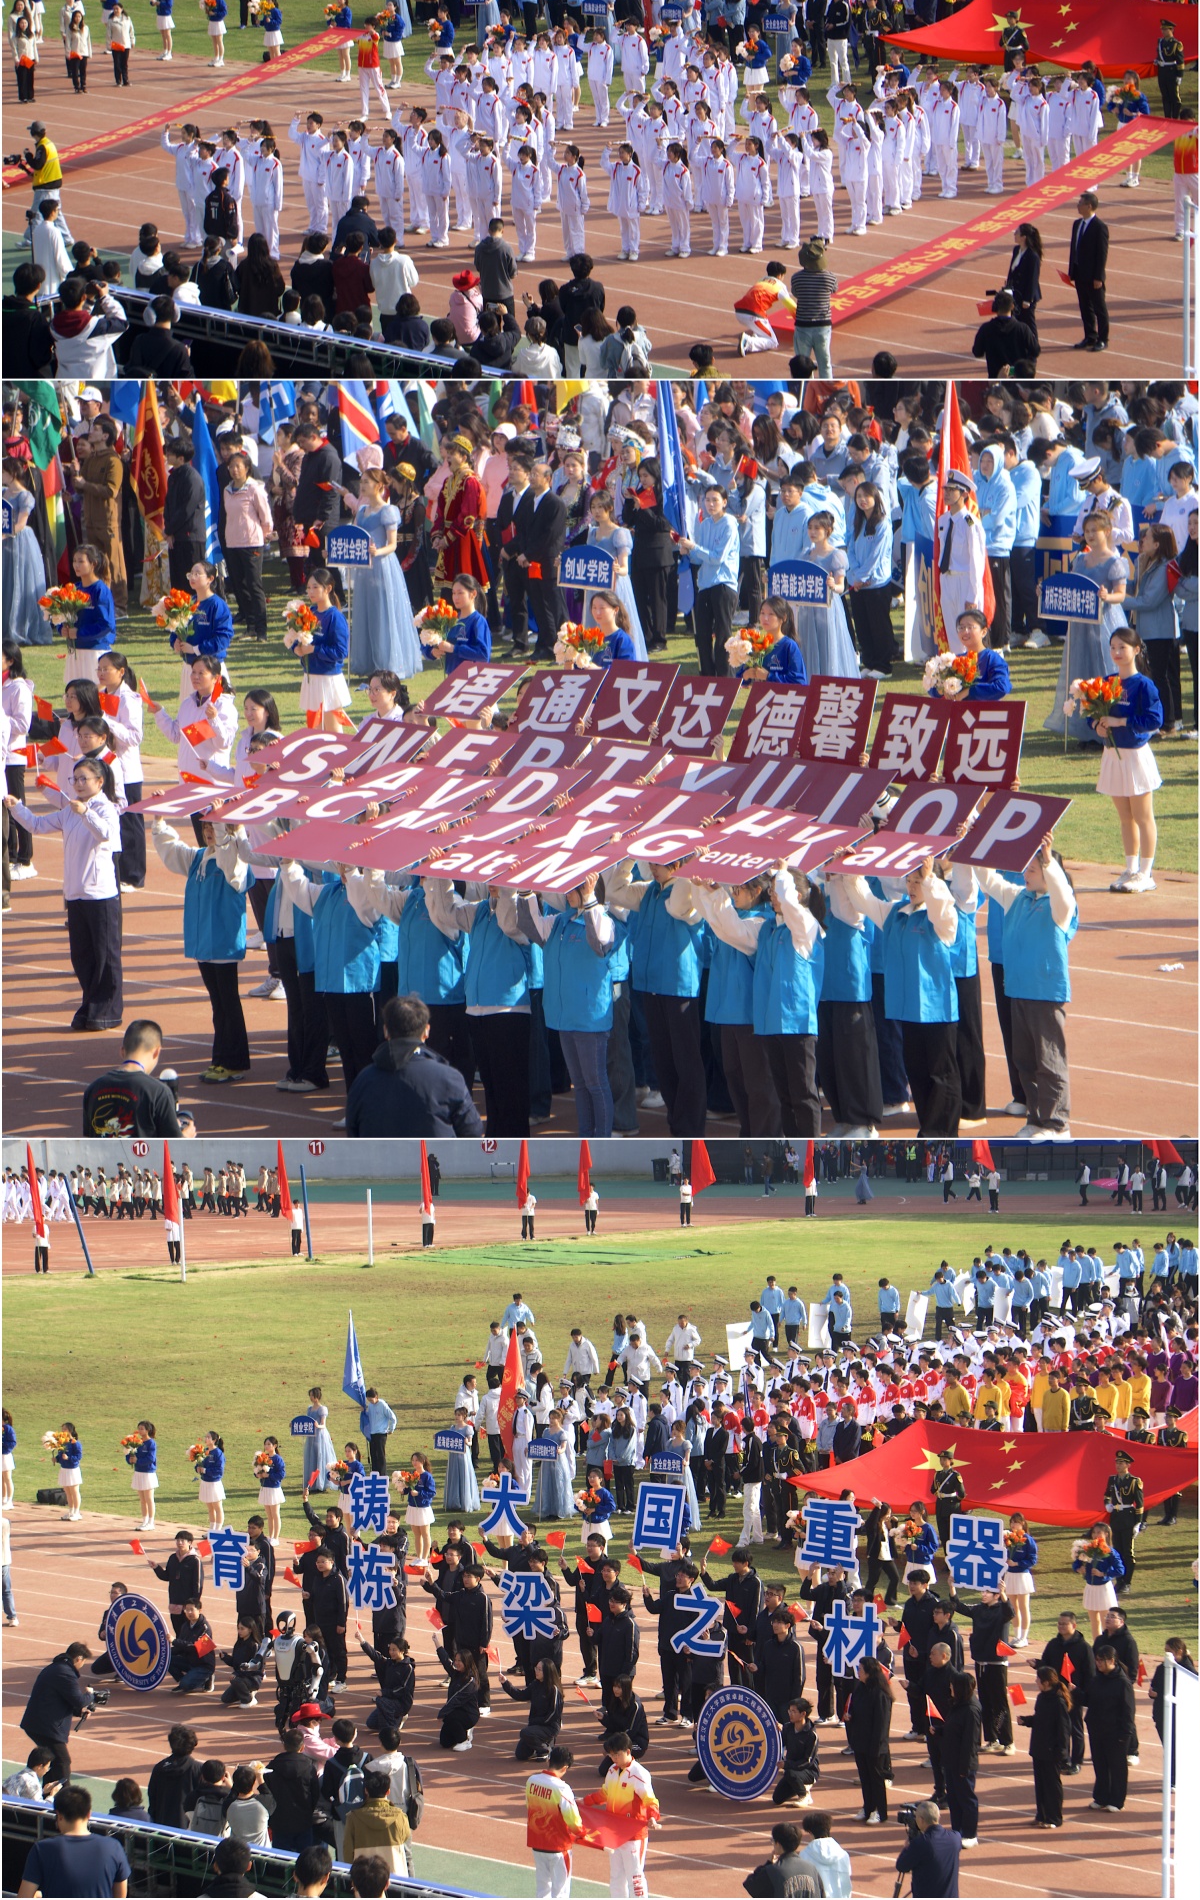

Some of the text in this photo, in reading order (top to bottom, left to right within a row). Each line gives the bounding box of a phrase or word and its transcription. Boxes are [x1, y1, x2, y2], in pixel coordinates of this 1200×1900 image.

[765, 18, 788, 31] 安全应急学院
[1064, 128, 1168, 180] 尚管明理
[965, 185, 1077, 234] 守正创新
[330, 537, 368, 561] 法学社会学院
[565, 557, 610, 584] 创业学院
[771, 572, 824, 599] 船海能动学院
[278, 743, 348, 782] S
[418, 778, 494, 811] V
[487, 771, 559, 813] D
[736, 760, 807, 811] U
[143, 787, 229, 814] Z
[222, 788, 300, 820] B
[305, 790, 378, 818] C
[532, 819, 621, 850] X
[720, 810, 792, 838] H
[970, 797, 1043, 860] P
[626, 829, 705, 857] G
[842, 842, 934, 869] alt
[430, 850, 519, 877] alt
[507, 851, 609, 889] M
[700, 848, 776, 871] enter
[134, 1143, 148, 1156] 10
[310, 1141, 322, 1154] 11
[483, 1140, 496, 1151] 12
[293, 1422, 314, 1434] 创业学院
[436, 1435, 463, 1450] 船海能动学院
[653, 1458, 681, 1471] 安全应急学院
[108, 1599, 159, 1635] 武汉理工大学
[109, 1629, 167, 1687] WUHAN UNIVERSITY OF TECHNOLOGY
[700, 1693, 771, 1741] 武汉理工大学国家卓越工程师学院
[529, 1783, 553, 1800] CHINA
